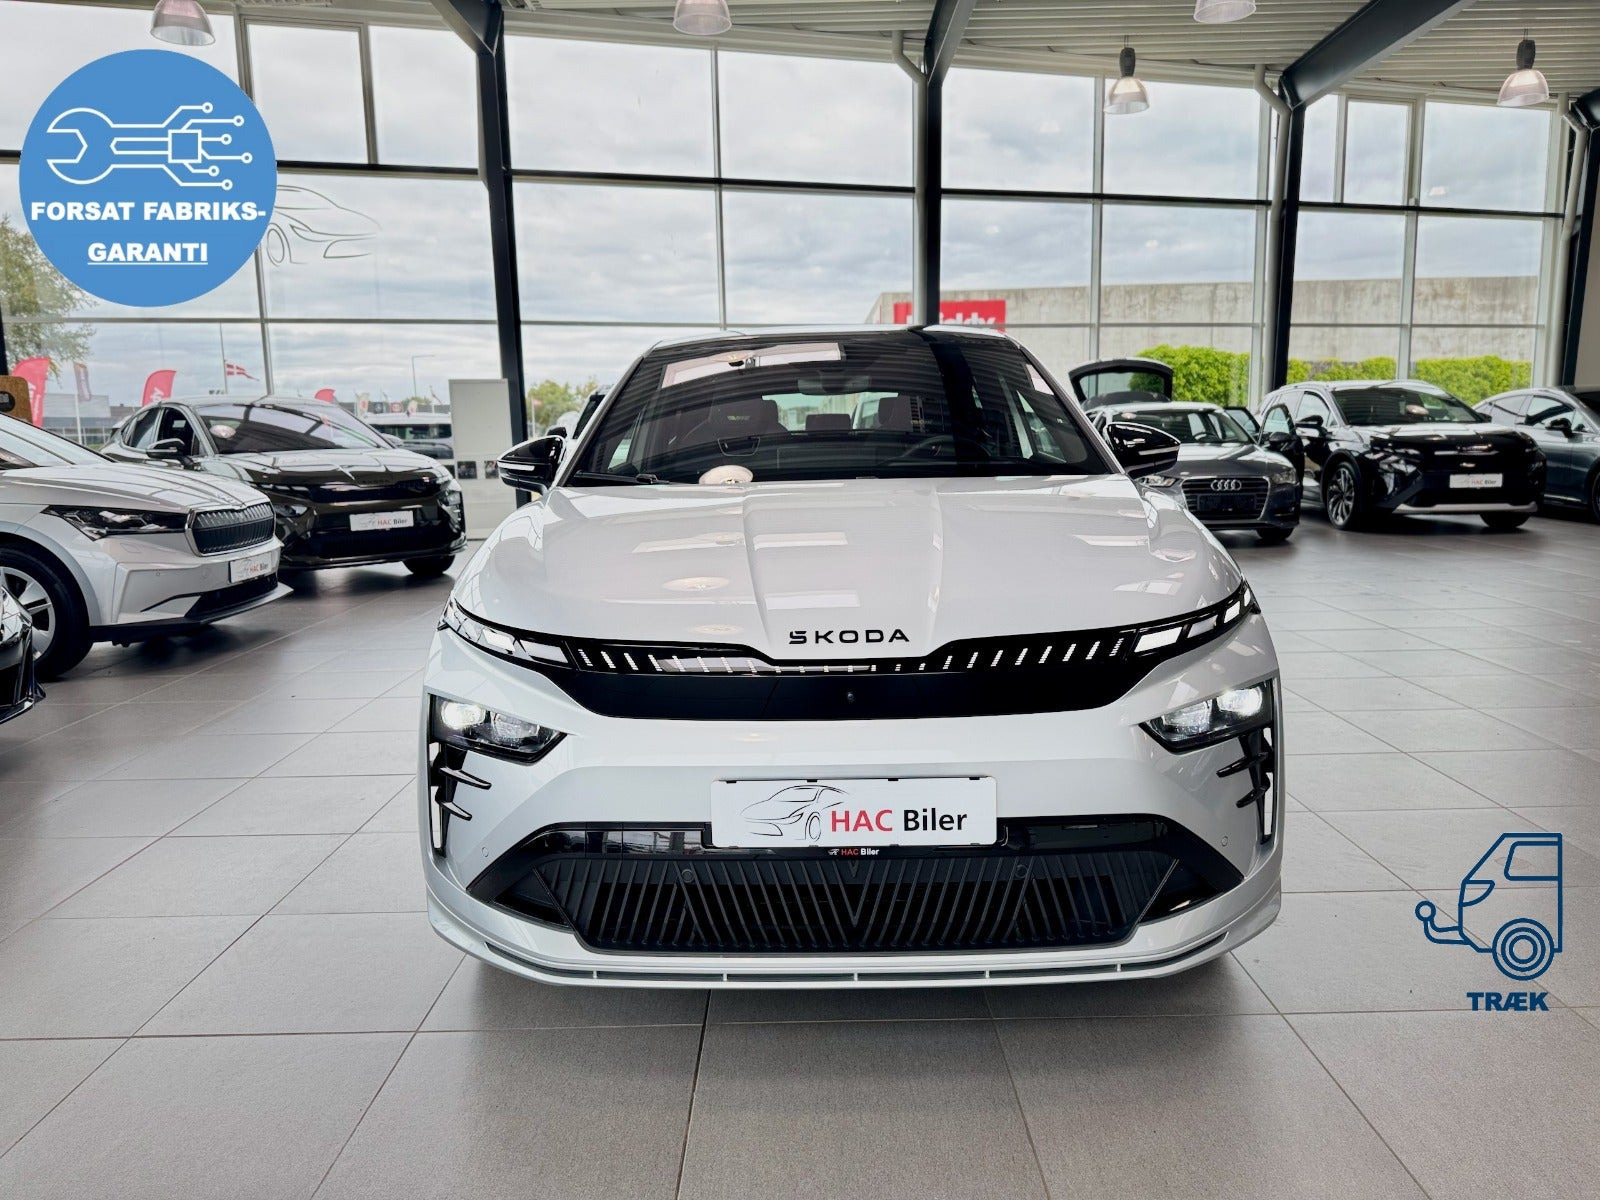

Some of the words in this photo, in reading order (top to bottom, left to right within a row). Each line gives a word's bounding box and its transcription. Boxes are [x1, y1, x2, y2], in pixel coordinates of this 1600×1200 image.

[831, 809, 893, 832] HAC
[903, 808, 968, 831] Biler
[841, 848, 859, 856] HAC
[860, 847, 880, 856] Biler
